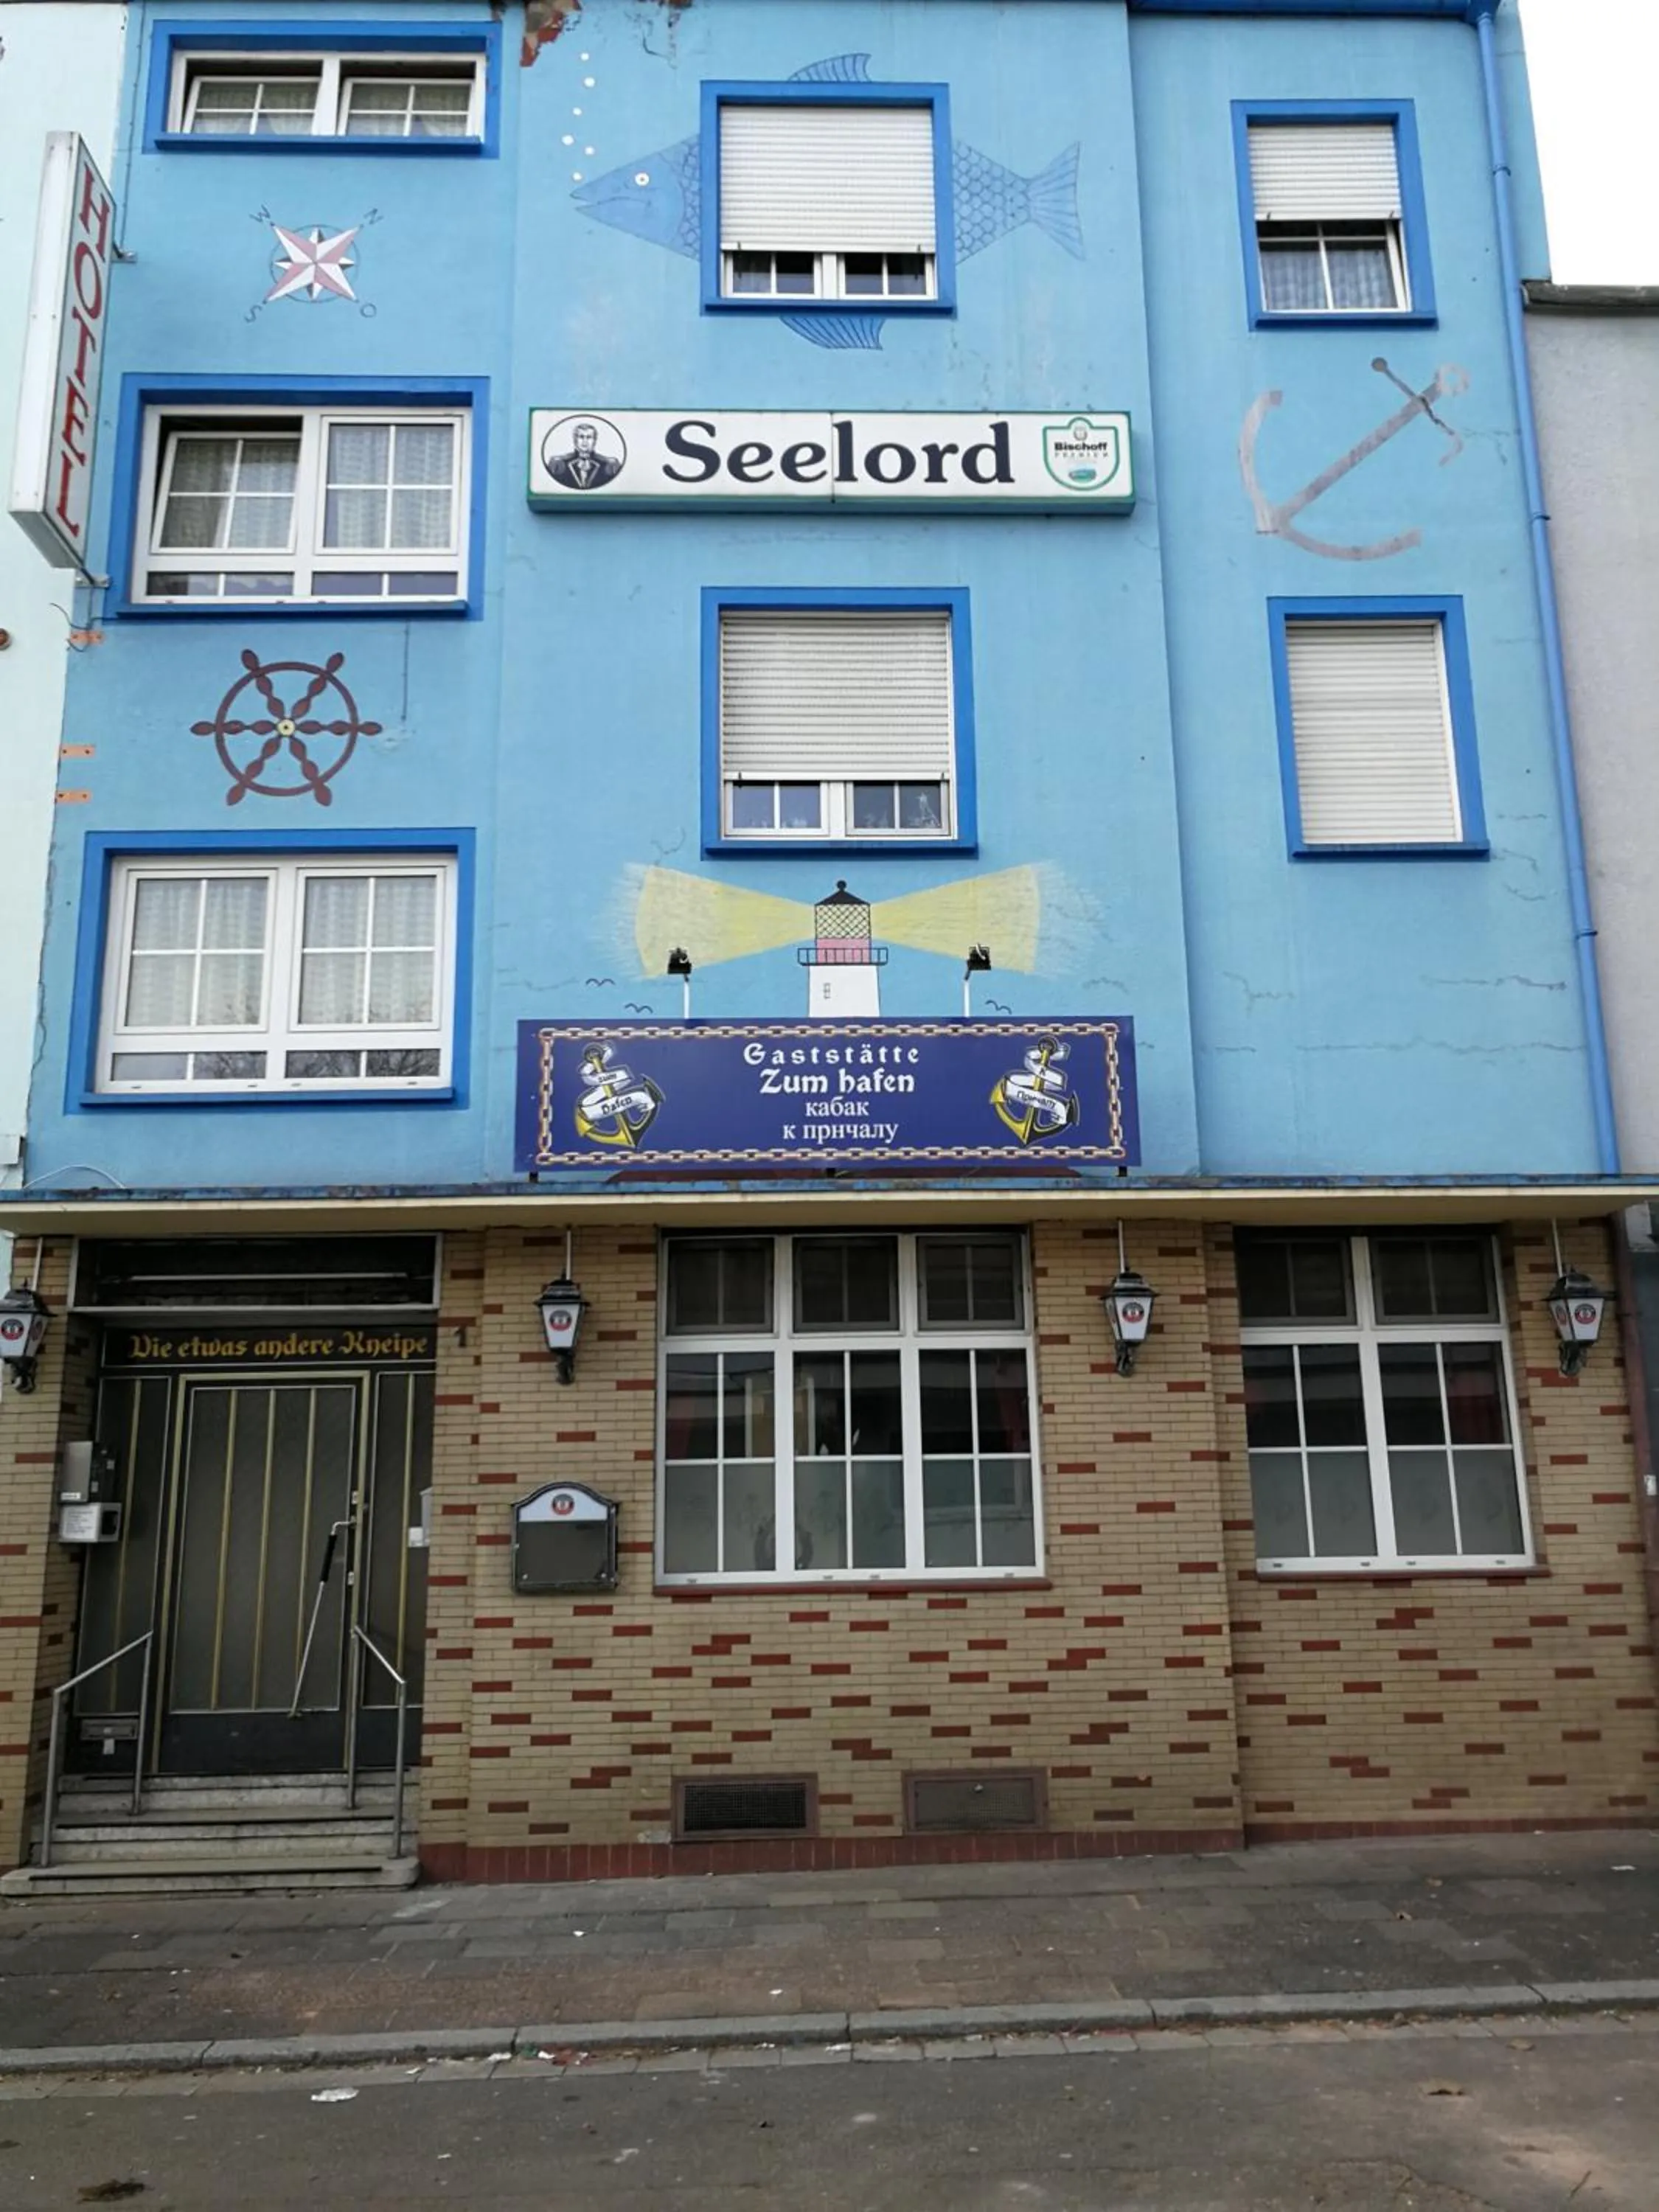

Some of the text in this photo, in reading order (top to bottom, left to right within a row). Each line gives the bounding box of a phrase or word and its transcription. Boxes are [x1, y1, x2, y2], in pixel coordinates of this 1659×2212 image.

[249, 203, 271, 223] W
[243, 303, 262, 324] S
[56, 160, 110, 538] HOTEL
[662, 420, 1016, 484] Seelord
[1054, 442, 1107, 451] Bischoff
[743, 1043, 919, 1065] Gaststätte
[759, 1068, 829, 1093] Zum
[805, 1096, 870, 1117] кабак
[783, 1124, 796, 1139] к
[177, 1332, 248, 1357] etwas
[254, 1332, 333, 1360] andere
[338, 1331, 428, 1359] Kneipe
